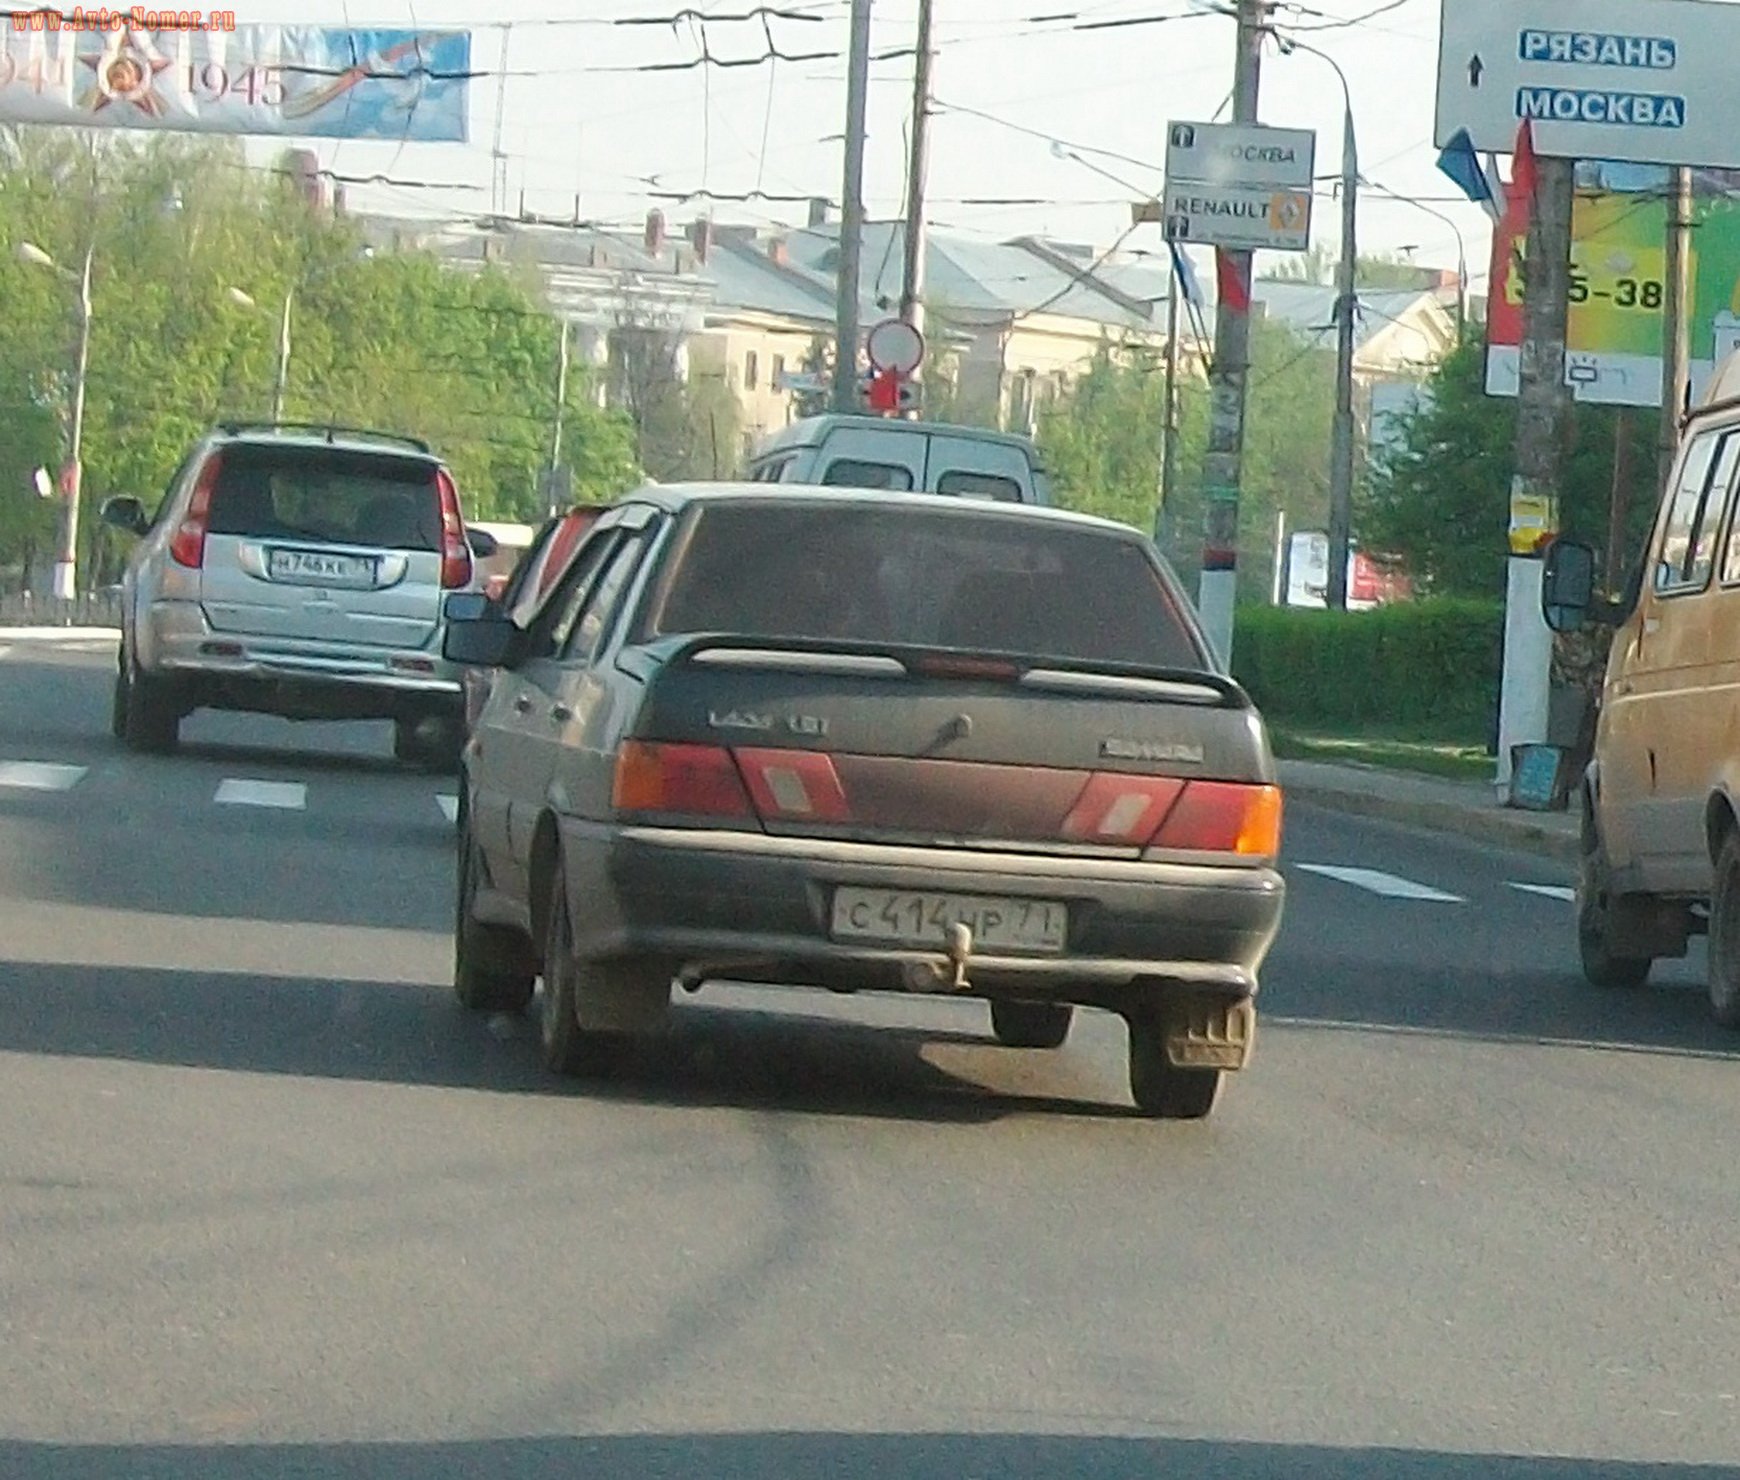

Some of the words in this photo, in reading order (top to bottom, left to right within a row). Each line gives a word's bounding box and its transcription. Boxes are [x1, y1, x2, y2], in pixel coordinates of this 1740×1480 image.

[1523, 30, 1675, 69] РЯЗАНЬ
[189, 63, 284, 106] 1945
[1519, 90, 1681, 126] МОСКВА
[1222, 144, 1296, 163] ОСКВА
[1174, 197, 1269, 218] RENAULT
